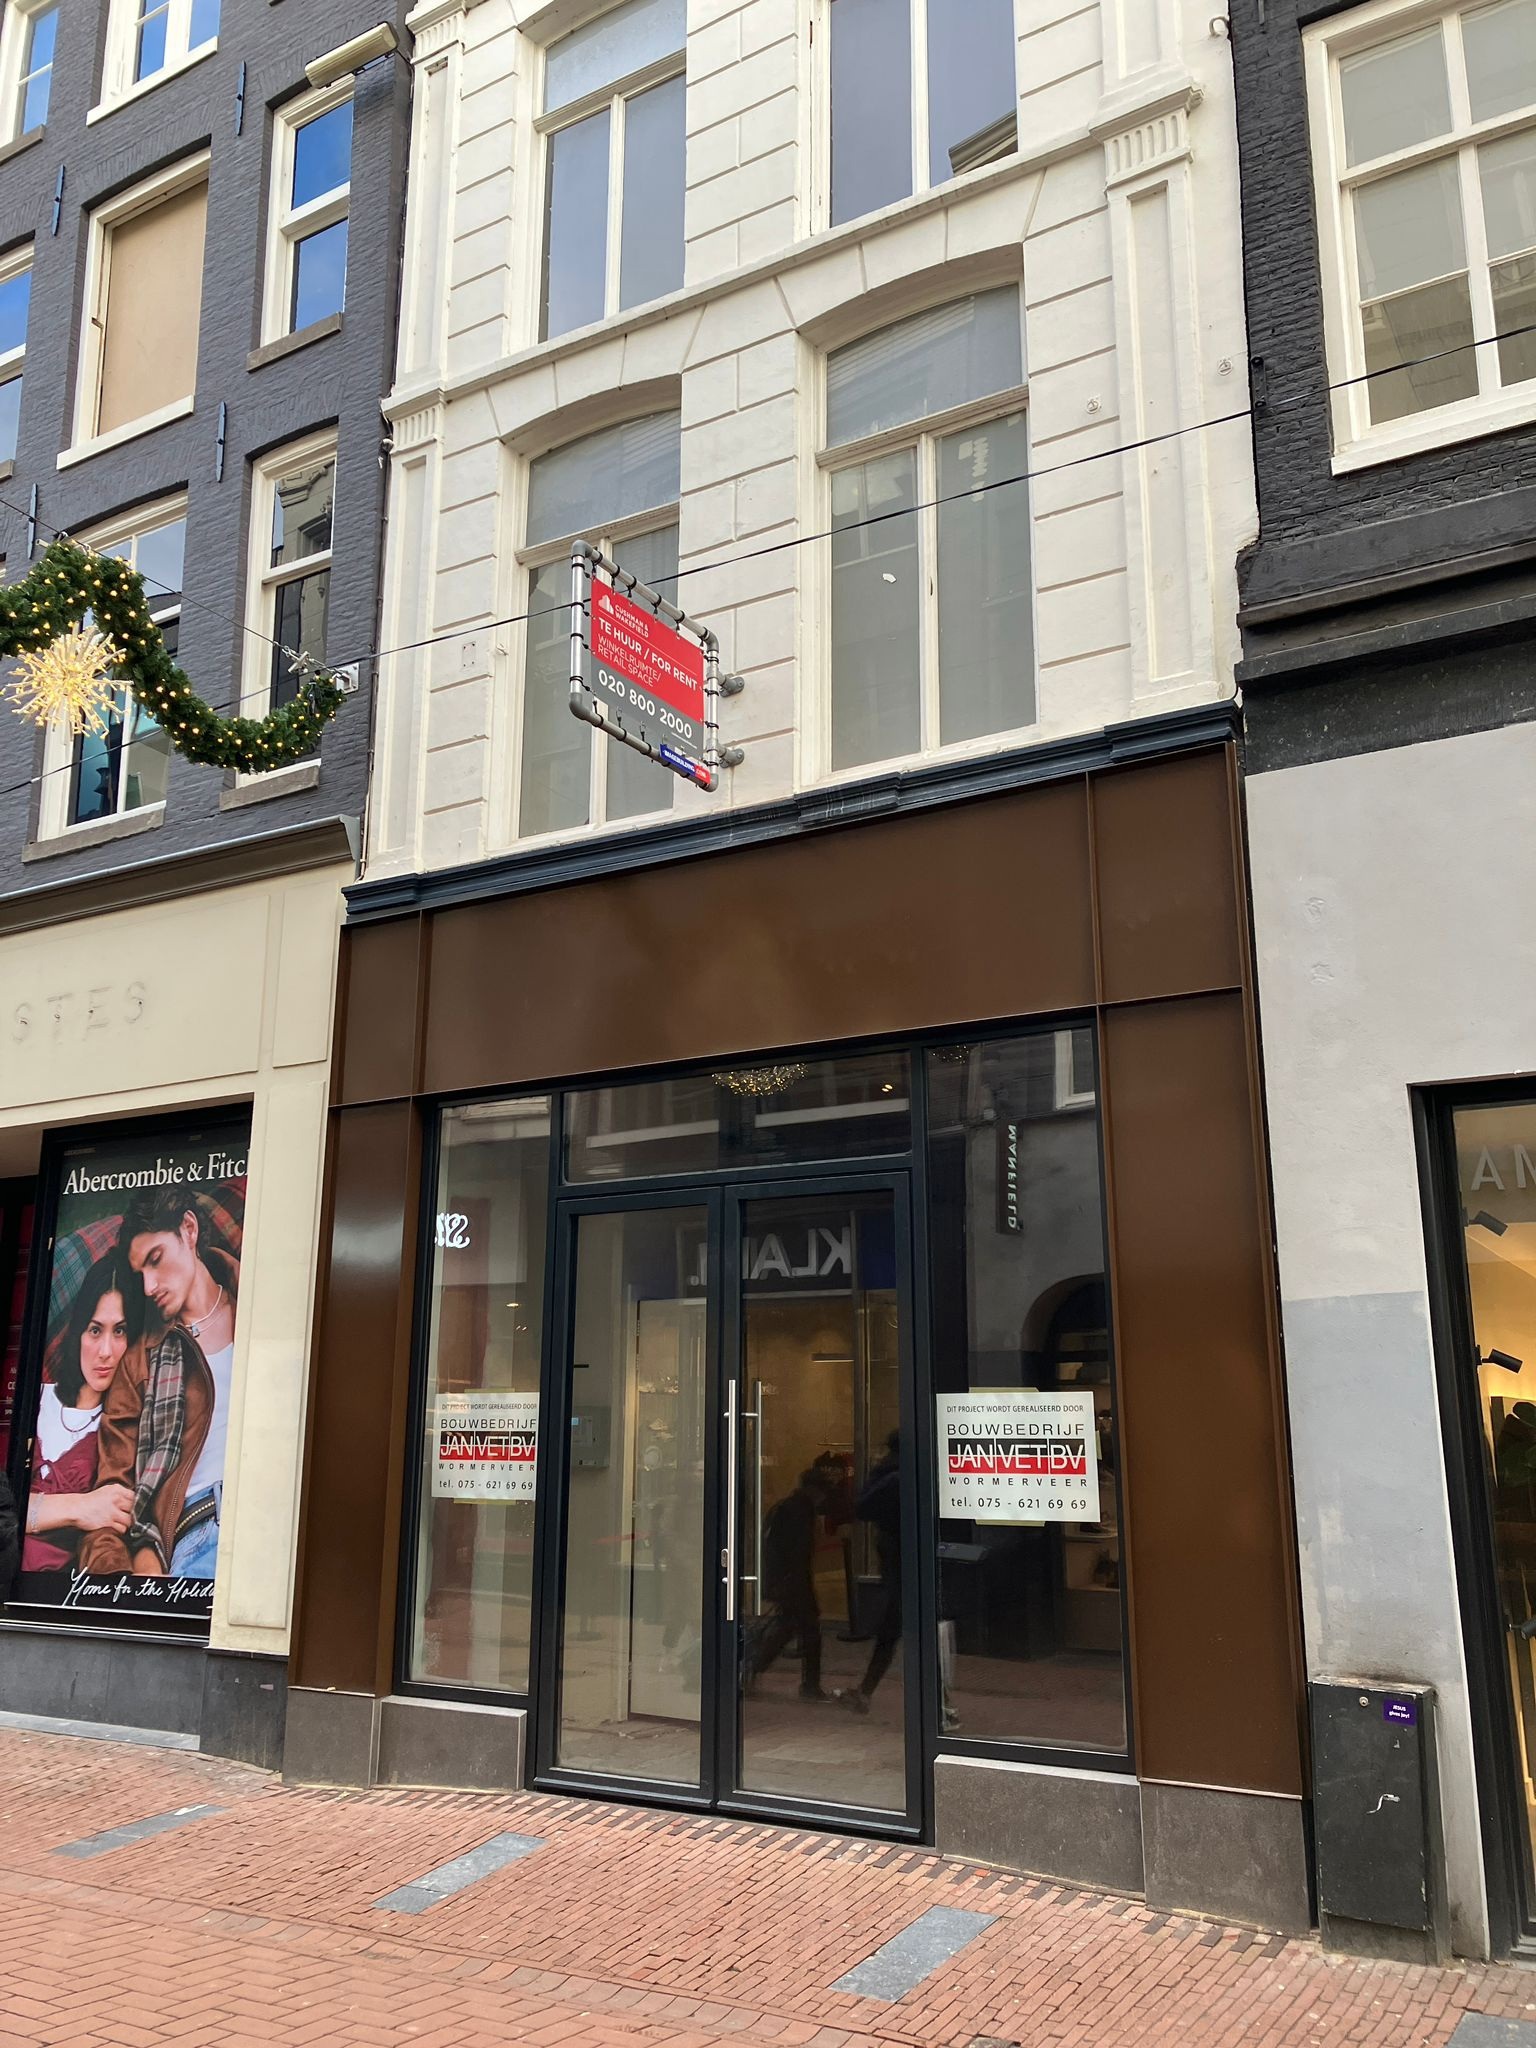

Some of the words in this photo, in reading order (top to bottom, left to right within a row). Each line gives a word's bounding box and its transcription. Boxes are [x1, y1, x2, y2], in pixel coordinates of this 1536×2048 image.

[614, 604, 644, 627] CUSHMAN
[615, 612, 649, 638] WAKEFIELD
[597, 634, 662, 681] WINKELRUIMTE/
[597, 644, 627, 670] RETAIL
[628, 664, 654, 687] SPACE
[598, 618, 612, 636] TE
[613, 629, 642, 656] HUUR
[644, 648, 650, 660] /
[651, 652, 672, 675] FOR
[673, 666, 698, 691] RENT
[598, 669, 626, 698] 020
[629, 688, 655, 717] 800
[659, 708, 693, 739] 2000
[62, 1157, 184, 1195] Abercrombie
[187, 1162, 204, 1182] &
[947, 1405, 957, 1413] DIT
[958, 1405, 985, 1413] PROJECT
[986, 1405, 1011, 1413] WORDT
[1013, 1405, 1061, 1413] GEREALISEERD
[1063, 1405, 1084, 1413] DOOR
[440, 1418, 537, 1429] BOUWBEDRIJF
[947, 1423, 1084, 1436] BOUWBEDRIJF
[440, 1435, 473, 1456] JAN
[475, 1435, 509, 1457] VET
[510, 1436, 535, 1457] BV
[949, 1444, 994, 1469] JAN
[997, 1444, 1047, 1469] VET
[1050, 1444, 1084, 1470] BV
[439, 1463, 535, 1472] WORMERVEER
[439, 1480, 454, 1488] tel.
[458, 1480, 475, 1489] 075
[486, 1480, 501, 1489] 621
[506, 1481, 517, 1490] 69
[521, 1481, 533, 1490] 69
[949, 1476, 1087, 1487] WORMERVEER
[951, 1497, 972, 1507] tel.
[978, 1498, 1001, 1508] 075
[1018, 1498, 1041, 1509] 621
[1048, 1499, 1064, 1509] 69
[1071, 1499, 1087, 1510] 69
[62, 1566, 111, 1607] Home
[135, 1578, 163, 1598] the
